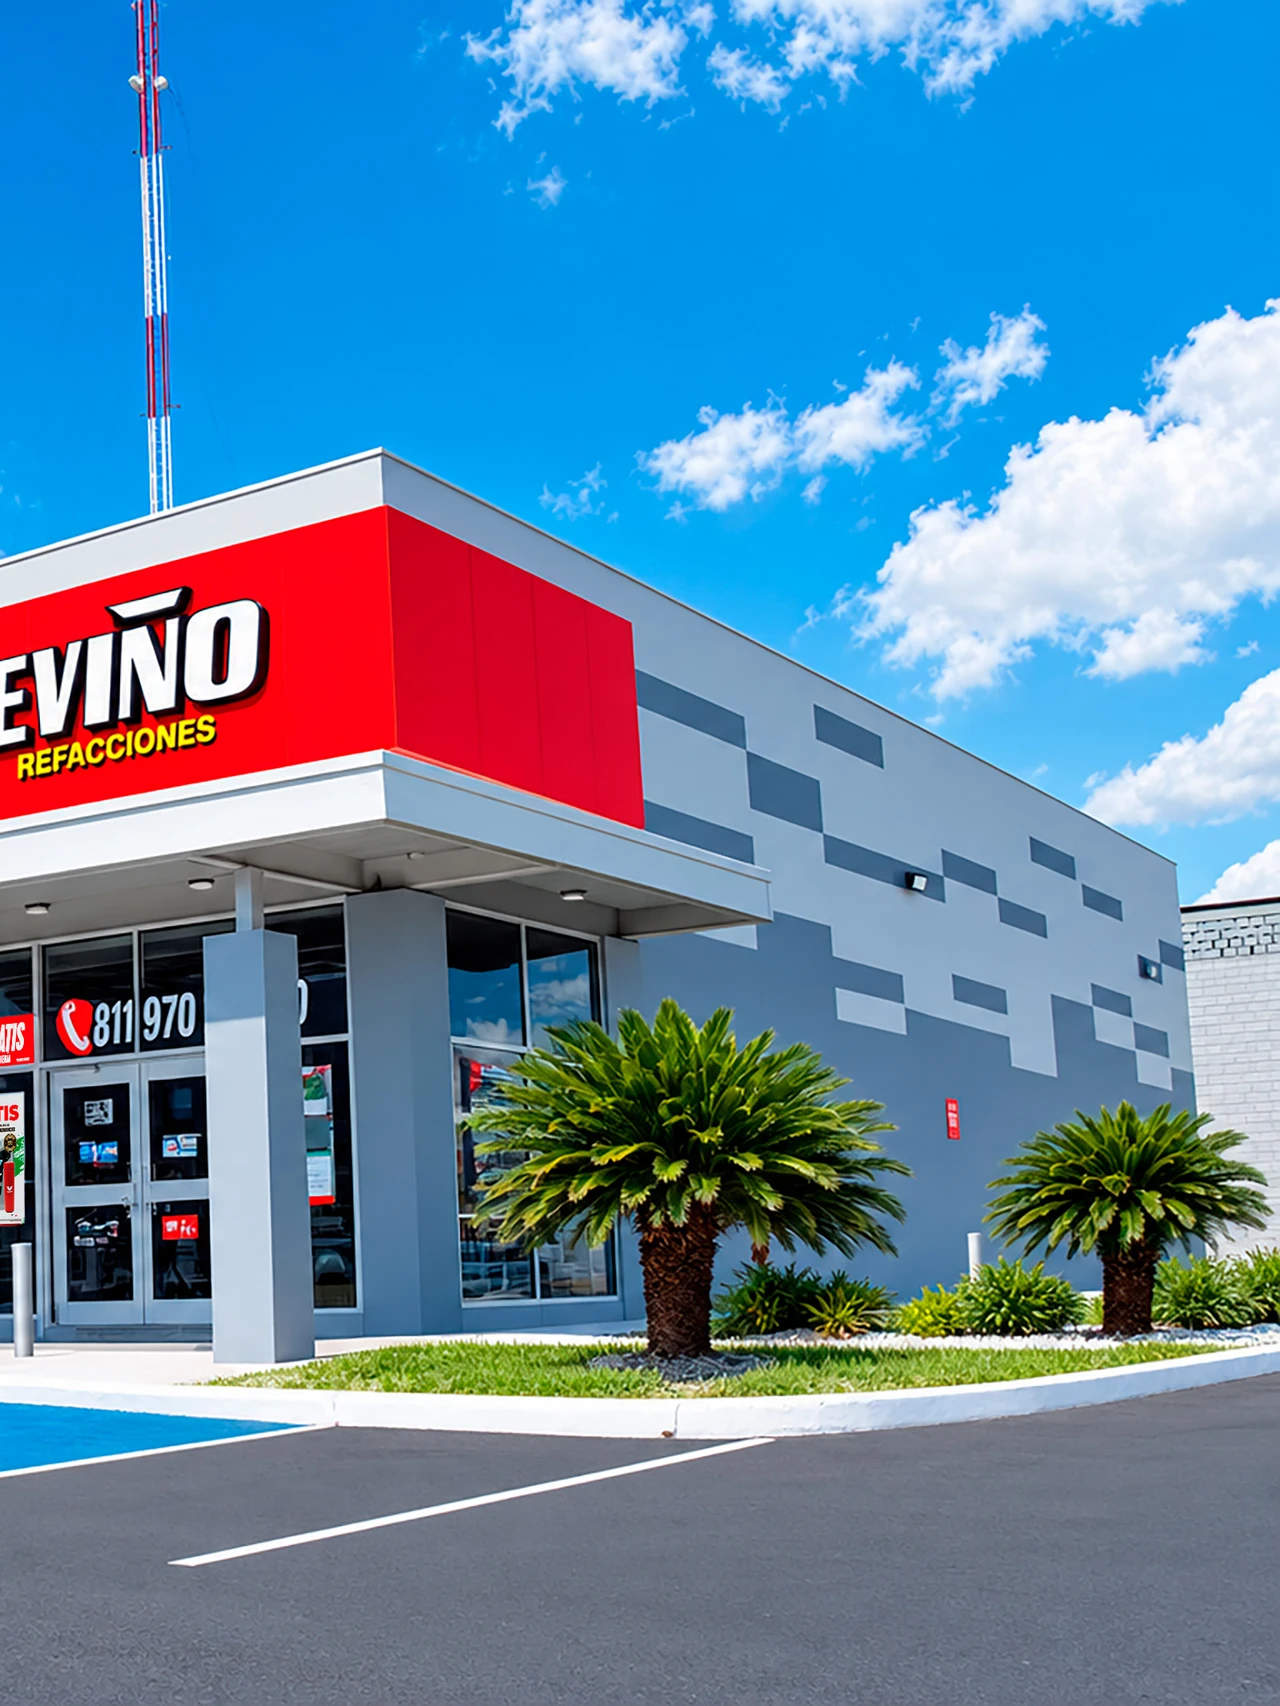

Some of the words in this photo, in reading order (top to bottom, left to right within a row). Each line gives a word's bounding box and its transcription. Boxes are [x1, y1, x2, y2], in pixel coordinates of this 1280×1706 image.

[17, 715, 217, 780] REFACCIONES
[93, 999, 133, 1047] 811
[143, 992, 196, 1042] 970
